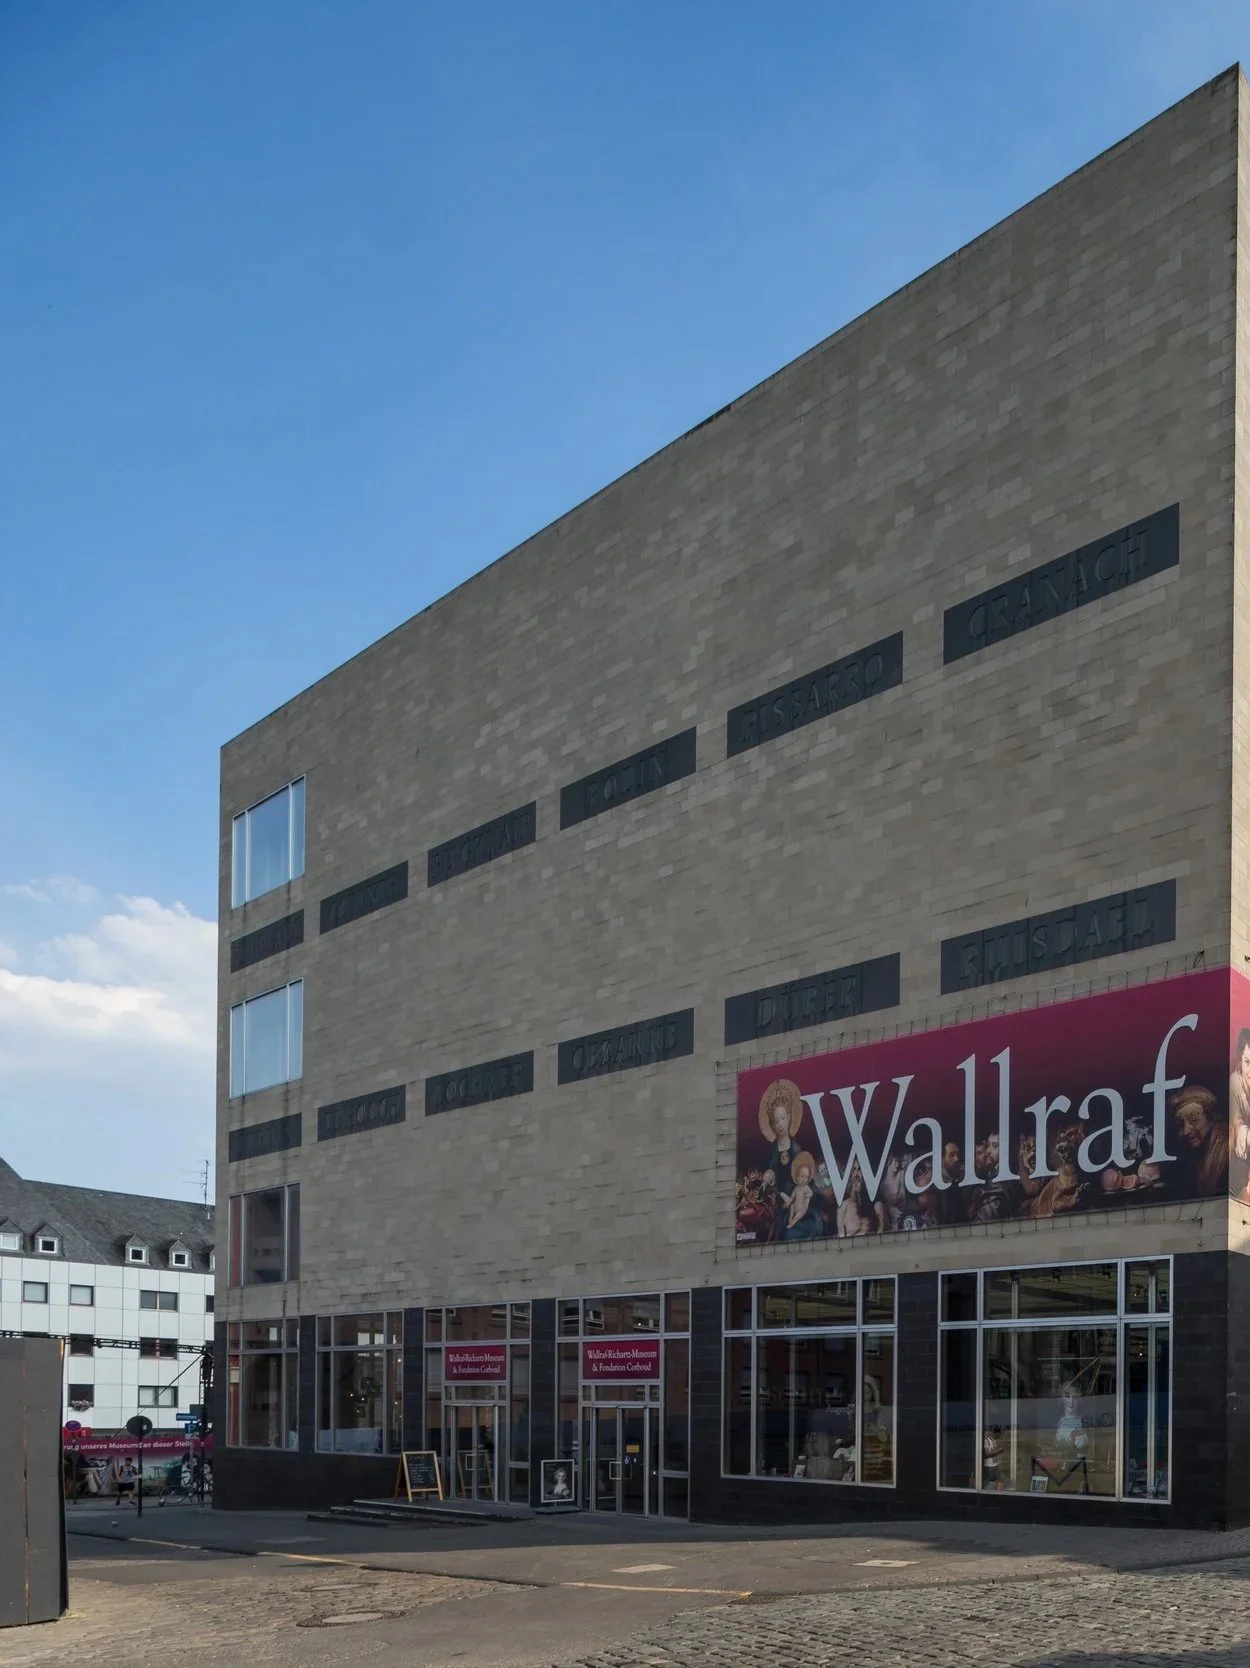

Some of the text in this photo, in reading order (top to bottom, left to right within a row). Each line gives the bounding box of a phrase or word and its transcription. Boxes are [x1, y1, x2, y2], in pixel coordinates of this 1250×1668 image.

[967, 527, 1153, 641] CRANACH
[739, 654, 884, 745] PISSARRO
[583, 751, 668, 811] RODIN
[959, 896, 1156, 987] RUISDAEL
[756, 974, 862, 1031] DÜRER
[800, 1014, 1199, 1207] Wallraf
[448, 1353, 505, 1362] Wallraf-Richartz-Museum
[458, 1365, 480, 1374] Fondation
[480, 1365, 501, 1373] Corboud
[586, 1348, 657, 1360] Wallraf-Richartz-Museum
[592, 1361, 652, 1372] & Fondation Corboud
